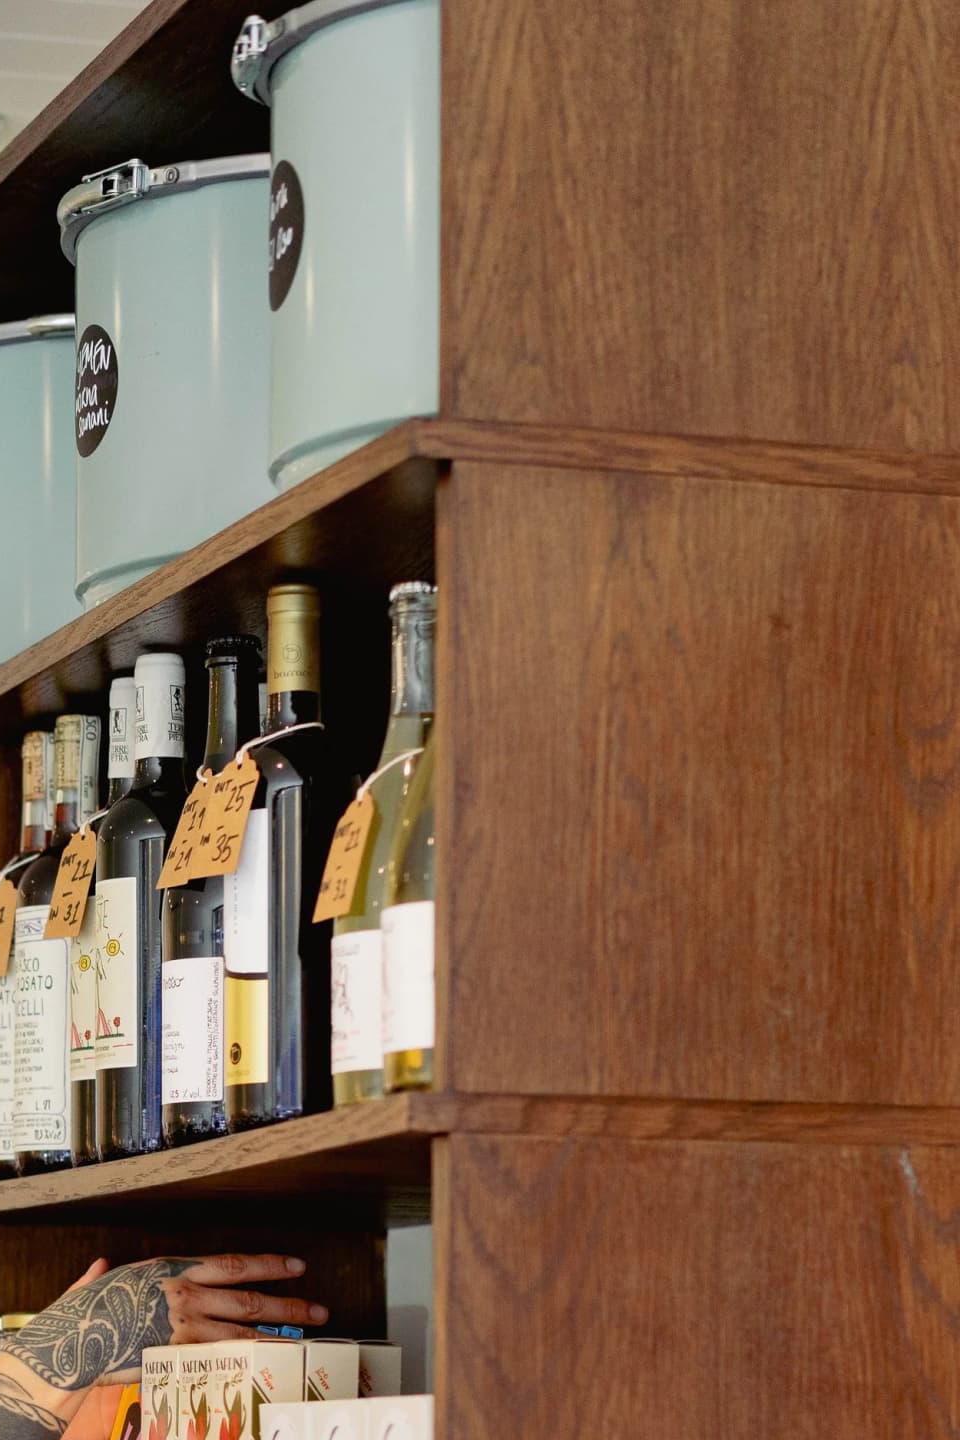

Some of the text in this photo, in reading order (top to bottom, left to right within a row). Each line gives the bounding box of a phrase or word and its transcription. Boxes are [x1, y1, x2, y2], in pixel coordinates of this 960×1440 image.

[214, 779, 256, 812] OUT 25
[211, 834, 239, 863] 35
[71, 859, 91, 882] 21
[63, 900, 81, 926] 31
